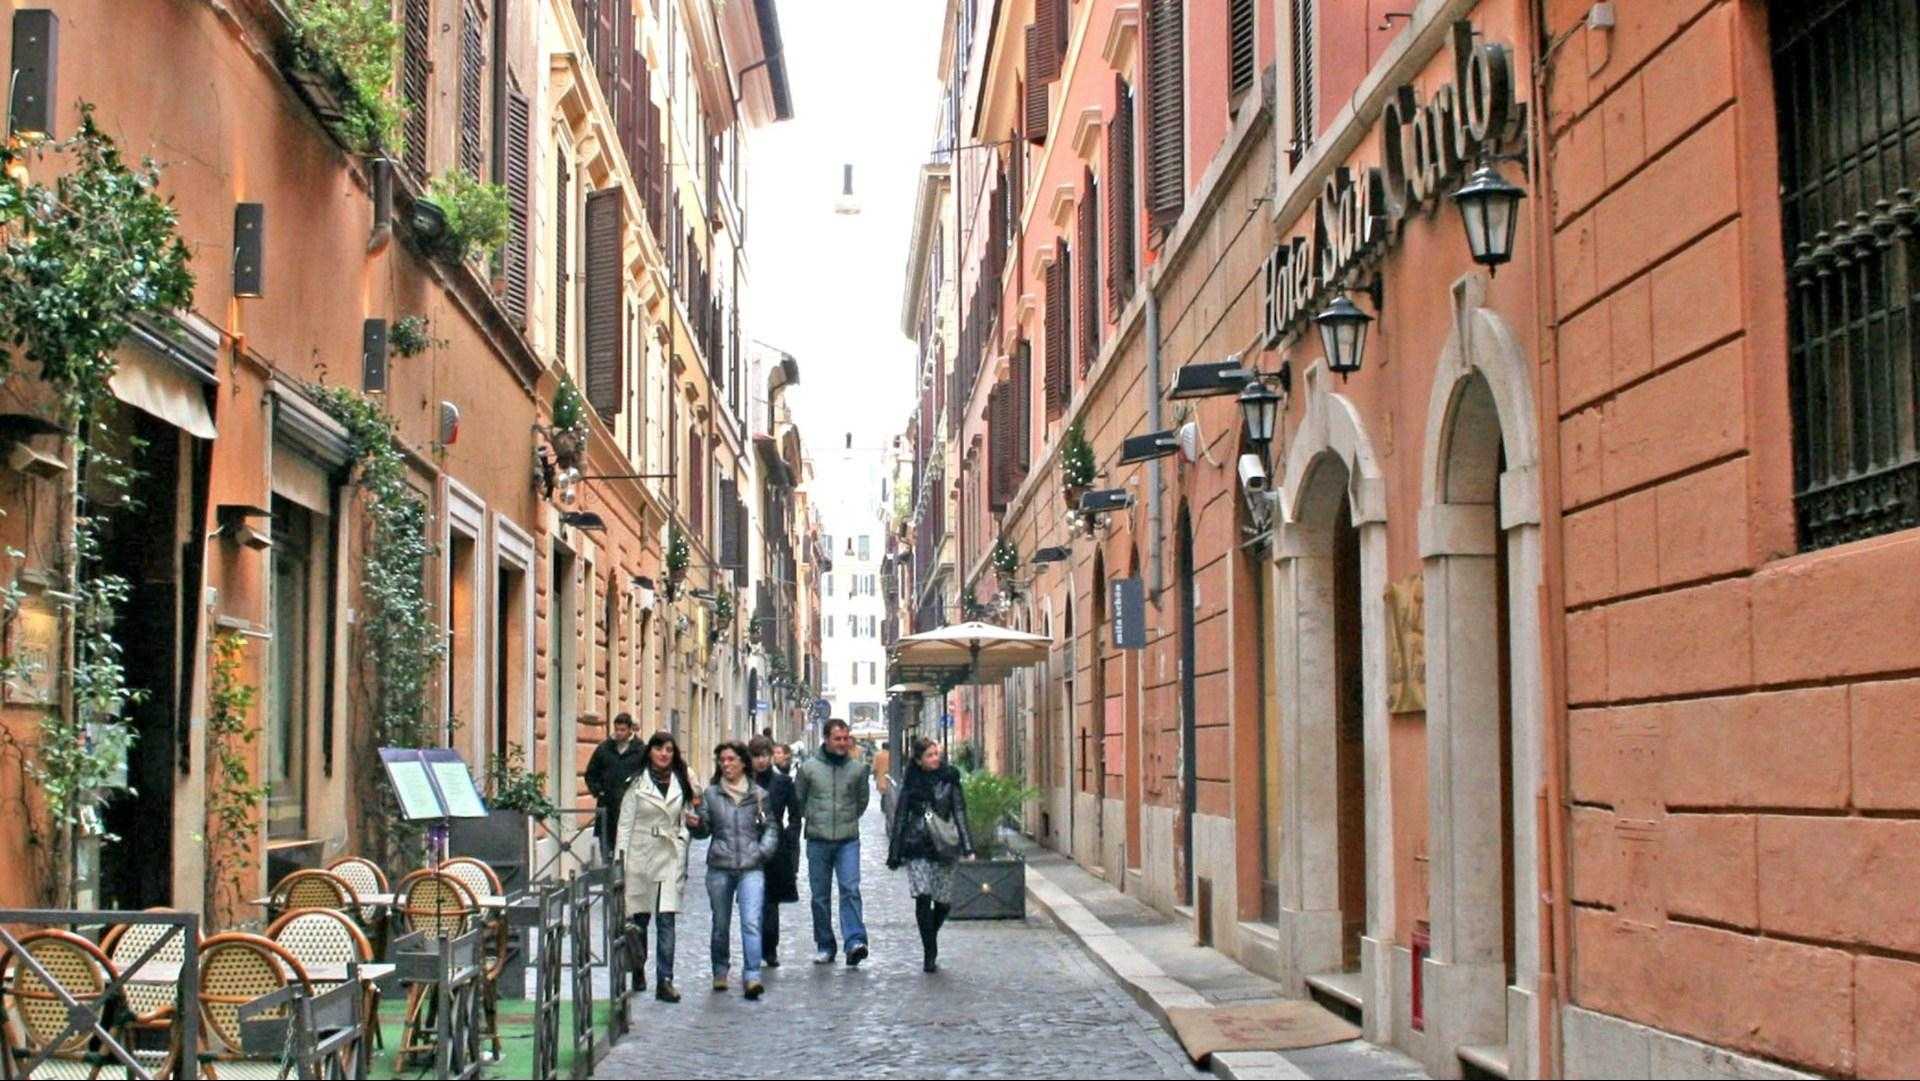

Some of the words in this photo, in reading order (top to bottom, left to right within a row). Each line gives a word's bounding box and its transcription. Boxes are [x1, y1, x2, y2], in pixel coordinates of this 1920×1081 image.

[1263, 198, 1321, 350] Hotel
[1321, 168, 1384, 289] San
[1379, 20, 1508, 219] Carlo
